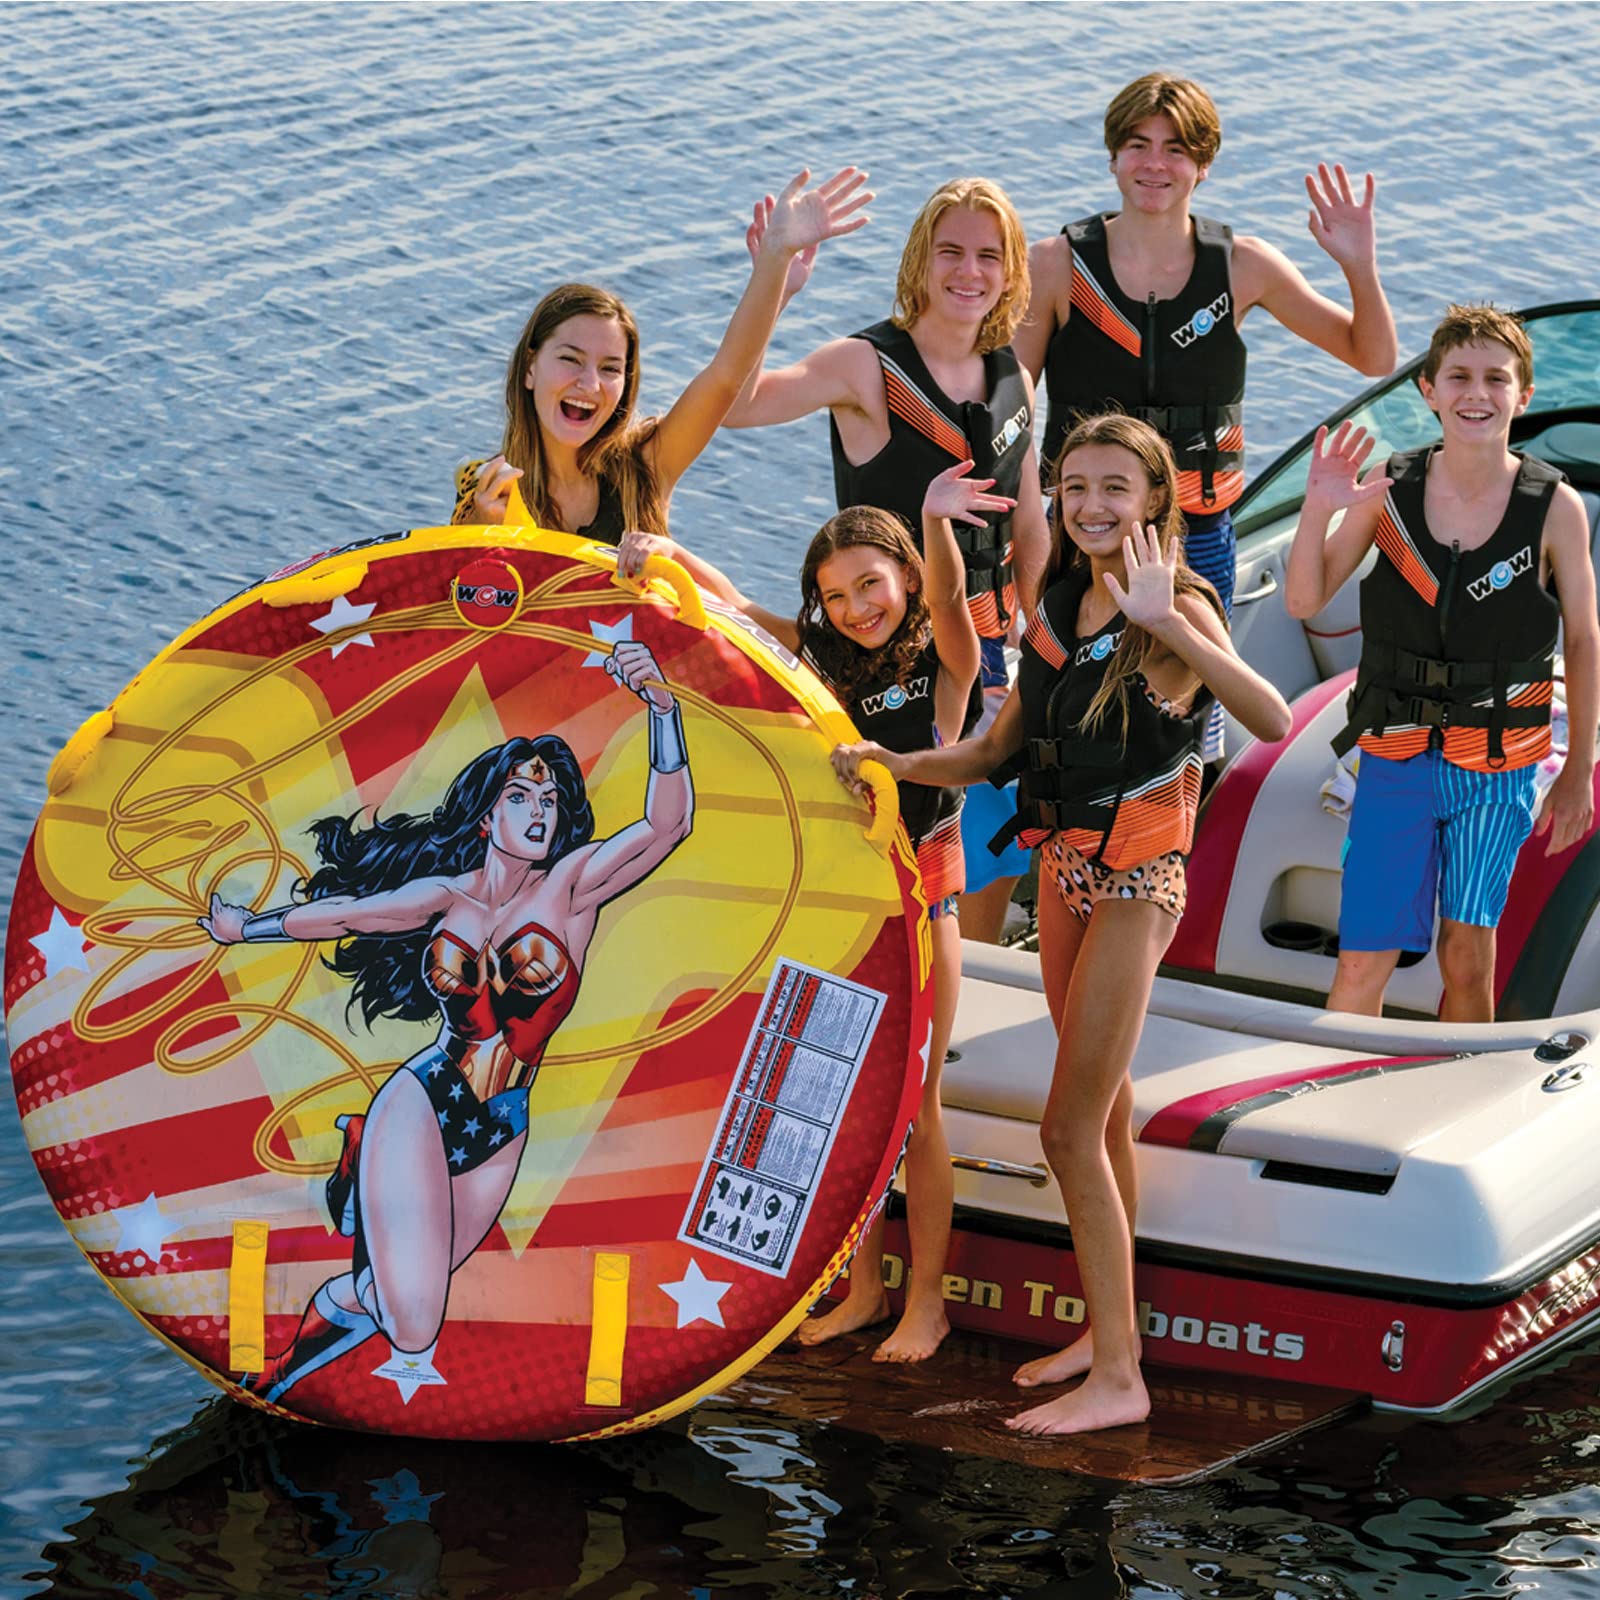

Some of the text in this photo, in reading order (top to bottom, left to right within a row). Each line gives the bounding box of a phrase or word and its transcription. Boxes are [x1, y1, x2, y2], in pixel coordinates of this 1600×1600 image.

[1170, 292, 1230, 348] WOW
[991, 405, 1029, 457] WOW
[457, 584, 519, 608] WOW
[1466, 545, 1533, 601] WOW
[862, 676, 928, 716] WOW
[1023, 1279, 1304, 1361] Toboats
